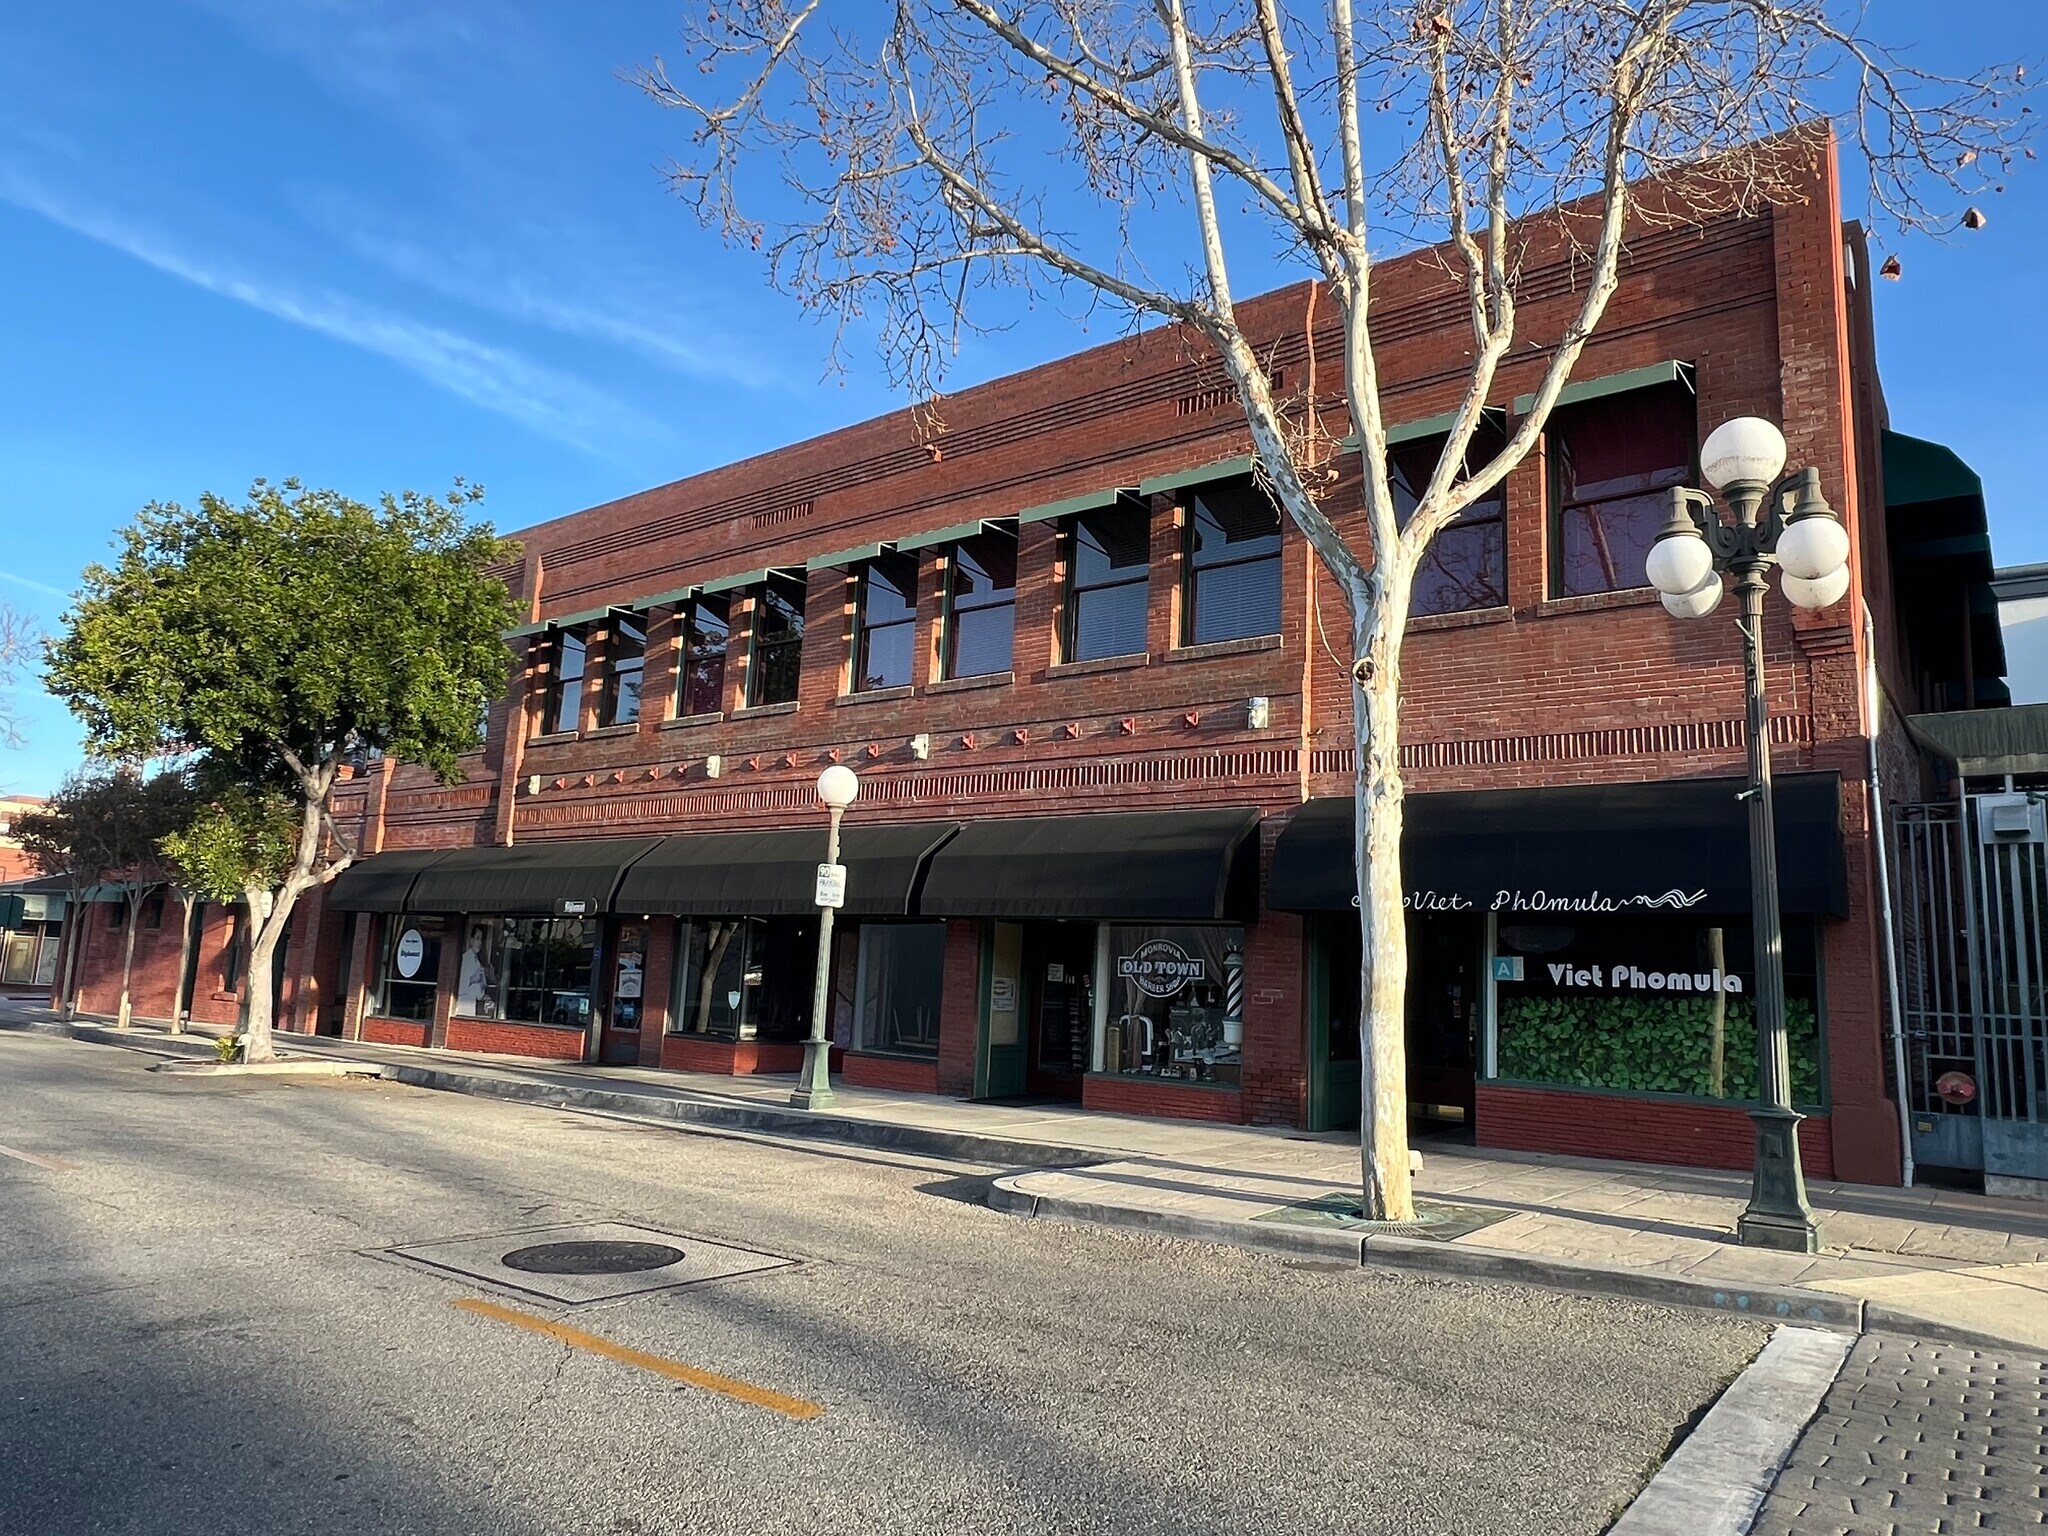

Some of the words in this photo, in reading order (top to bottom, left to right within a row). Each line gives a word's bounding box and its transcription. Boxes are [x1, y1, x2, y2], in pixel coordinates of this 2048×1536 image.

[1408, 890, 1473, 910] Viet
[1140, 943, 1182, 960] MONROVIA
[1121, 961, 1153, 974] OLD
[1154, 961, 1200, 976] TOWN
[1139, 976, 1165, 993] BARBER
[1165, 976, 1182, 993] SHOP
[1547, 963, 1603, 988] Viet
[1611, 965, 1743, 993] Phomula
